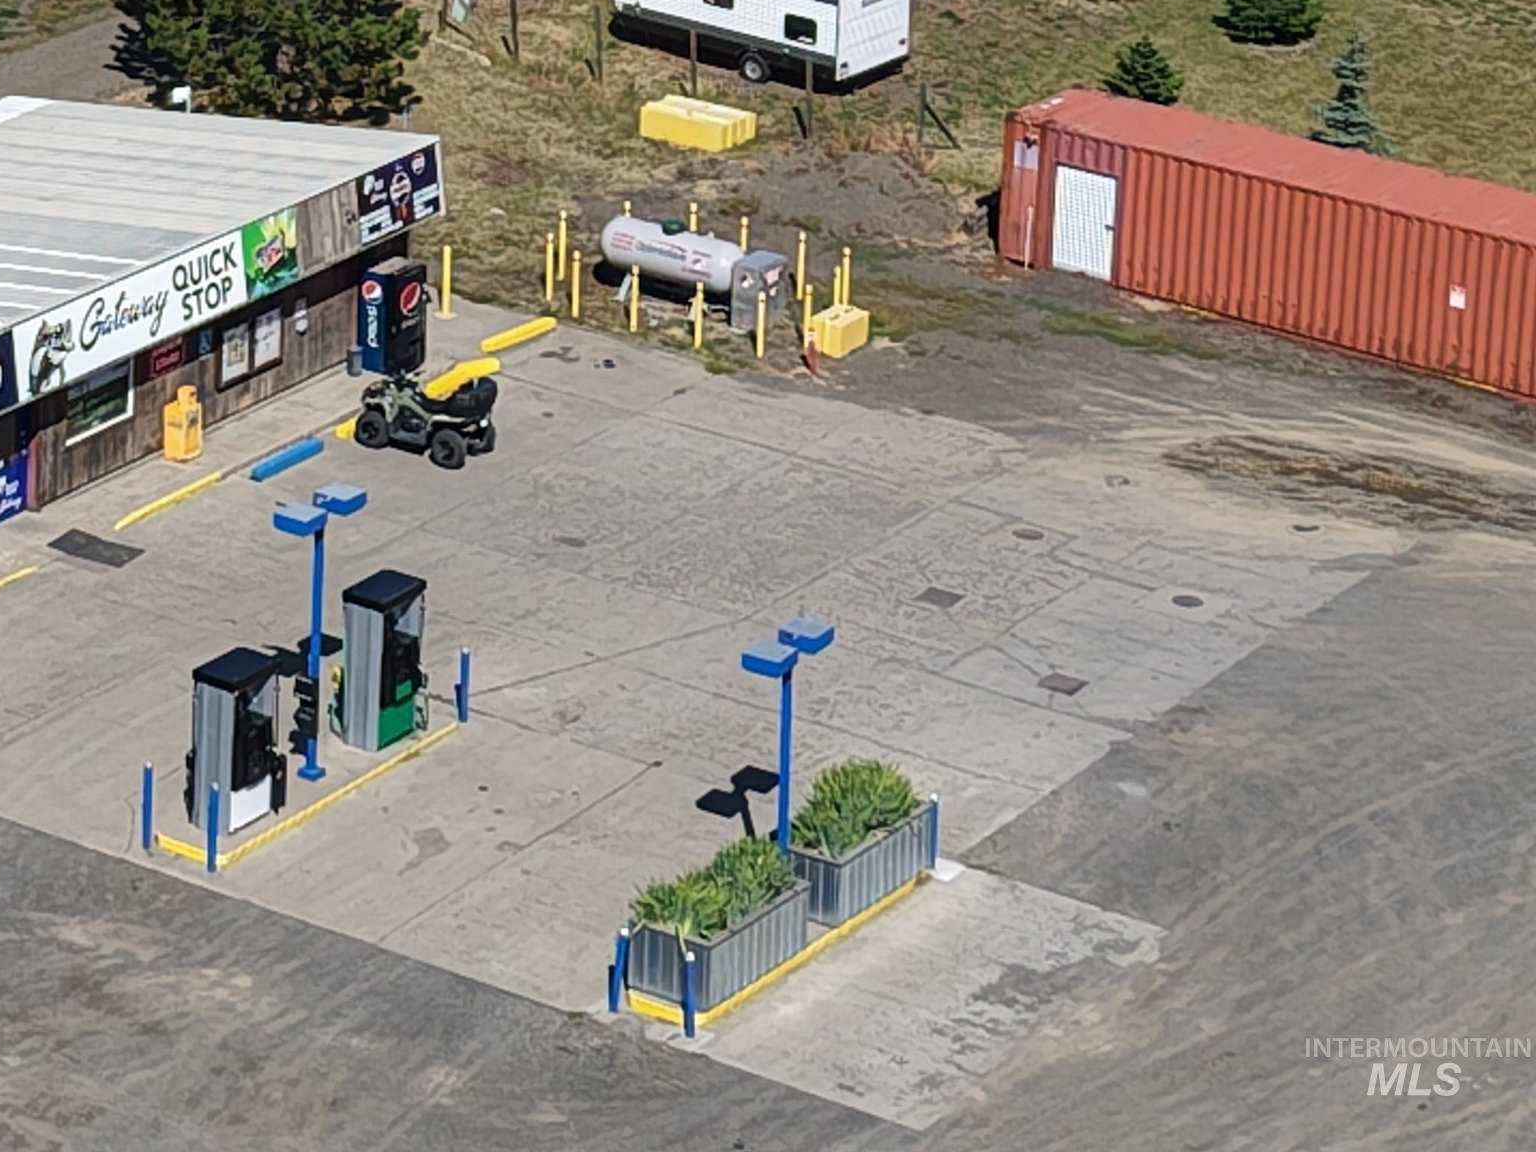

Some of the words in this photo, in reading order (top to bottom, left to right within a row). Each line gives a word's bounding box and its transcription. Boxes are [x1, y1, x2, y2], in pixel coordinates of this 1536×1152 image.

[172, 242, 238, 292] QUICK
[79, 290, 168, 352] Gateway
[181, 276, 233, 321] STOP
